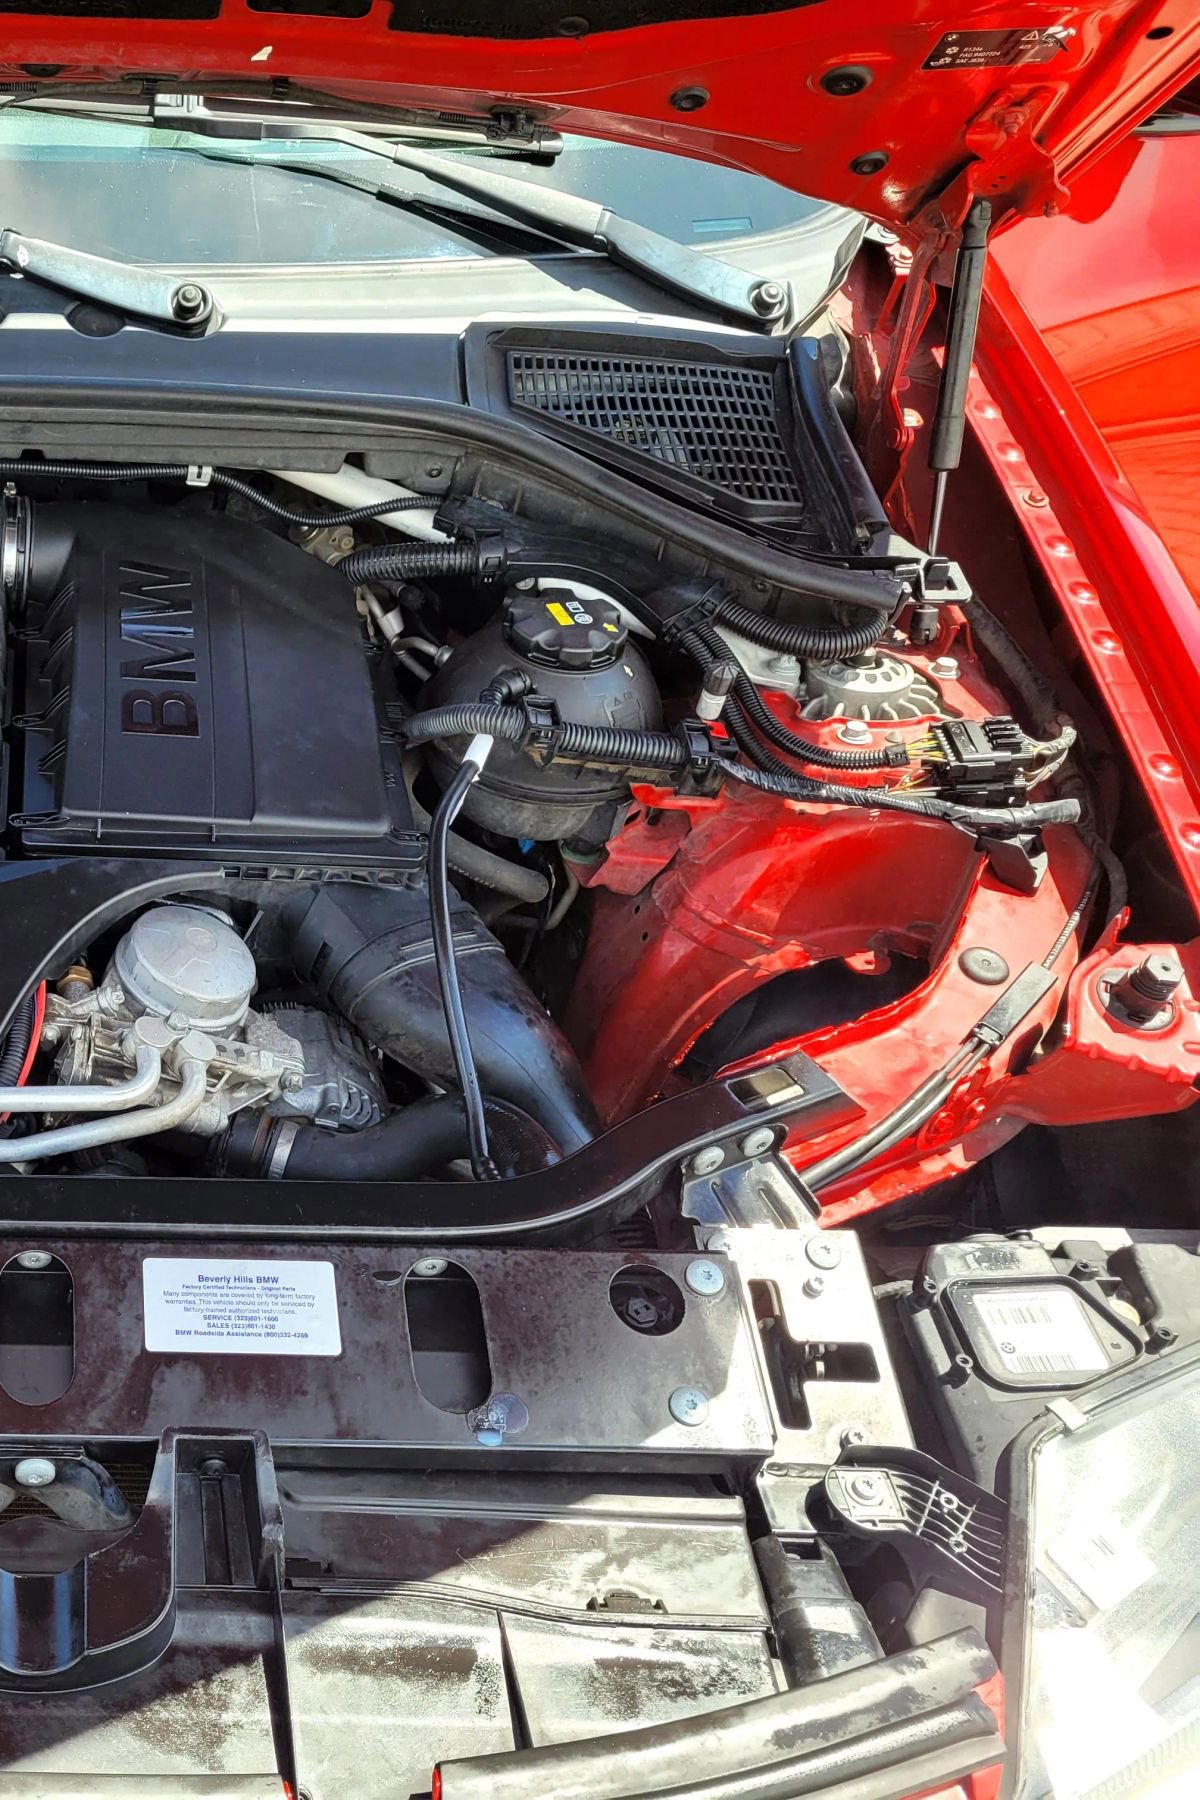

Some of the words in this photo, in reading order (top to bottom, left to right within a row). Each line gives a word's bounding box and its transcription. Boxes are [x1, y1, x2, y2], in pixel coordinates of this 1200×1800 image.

[118, 560, 200, 739] BMW
[198, 1275, 230, 1284] Beverly
[234, 1275, 253, 1284] Hills
[256, 1276, 279, 1284] BMW
[181, 1291, 218, 1299] components
[256, 1292, 264, 1300] by
